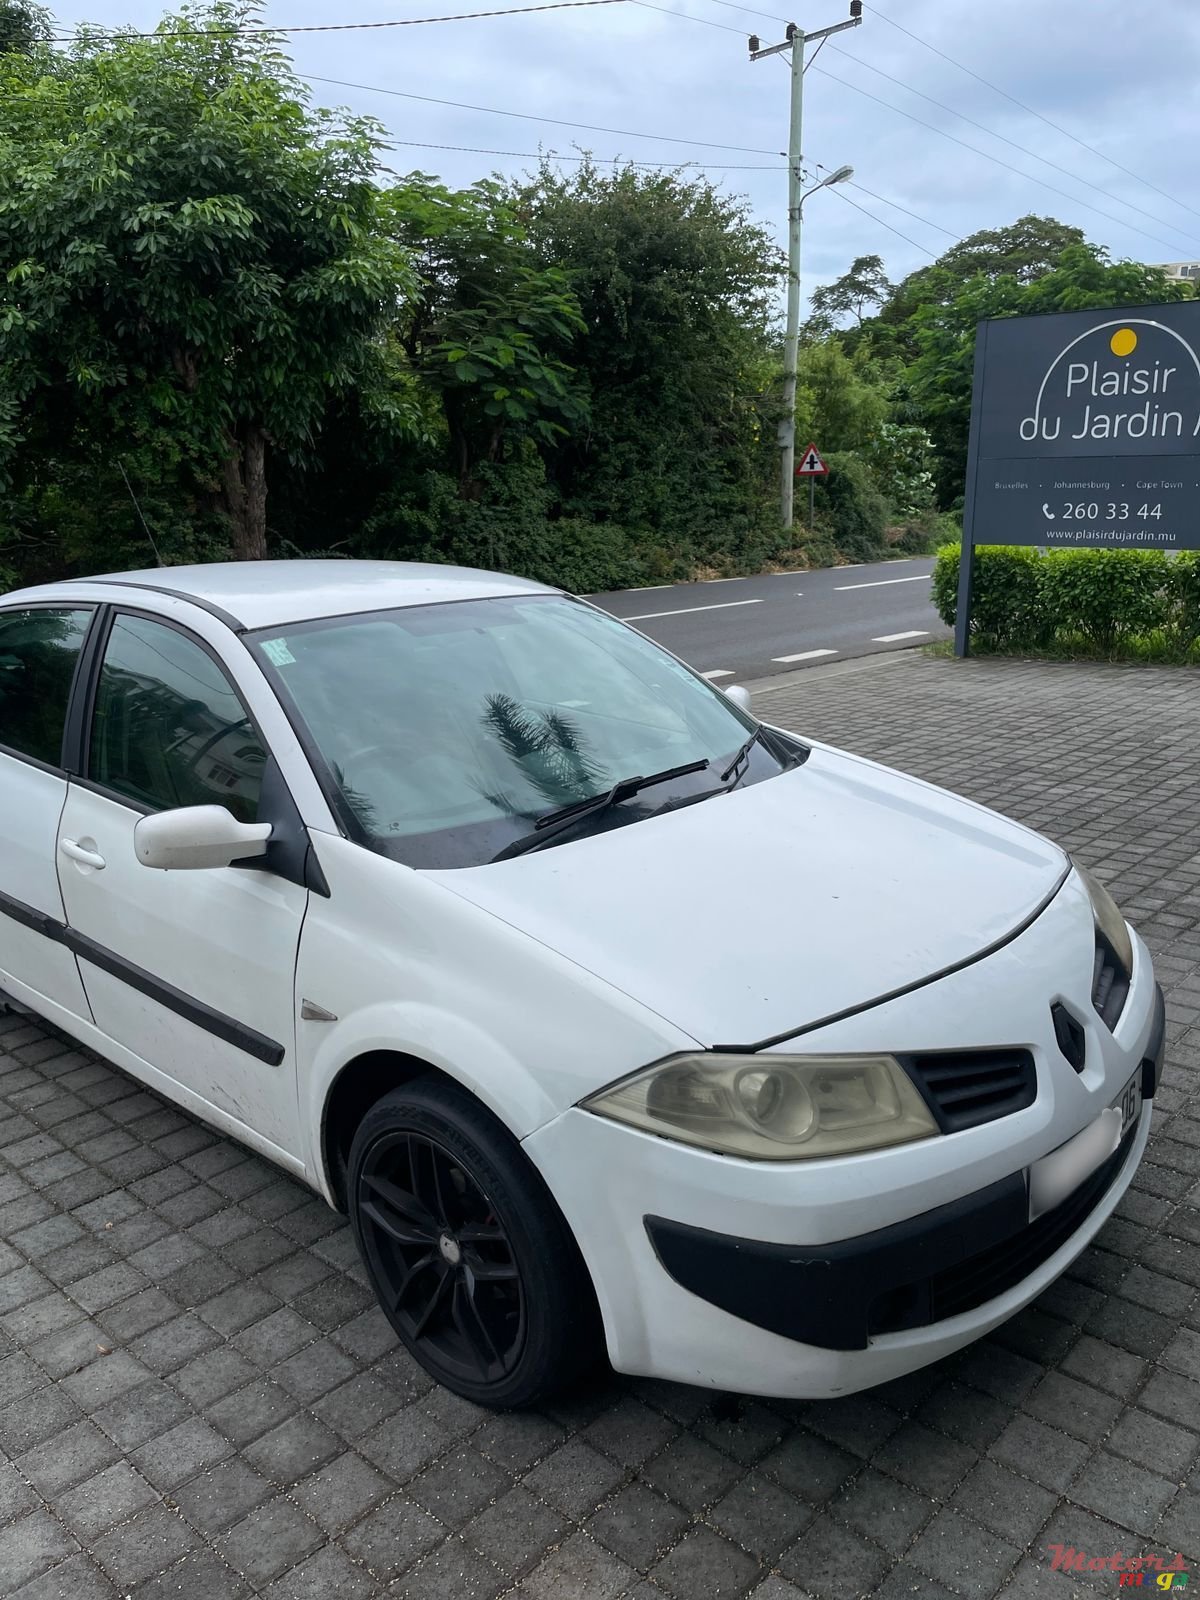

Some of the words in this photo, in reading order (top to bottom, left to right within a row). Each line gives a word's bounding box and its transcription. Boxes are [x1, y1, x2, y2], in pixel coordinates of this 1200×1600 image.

[1066, 360, 1176, 398] Plaisir
[1019, 408, 1061, 441] du
[1072, 401, 1183, 440] Jardin
[994, 481, 1029, 490] Bruxelles
[1053, 480, 1111, 491] Johannesburg
[1136, 480, 1159, 491] Cape
[1160, 480, 1184, 490] Town
[1062, 502, 1099, 520] 260
[1105, 503, 1130, 520] 33
[1136, 503, 1163, 520] 44
[1046, 529, 1176, 542] www.plaisirdujardin.mu
